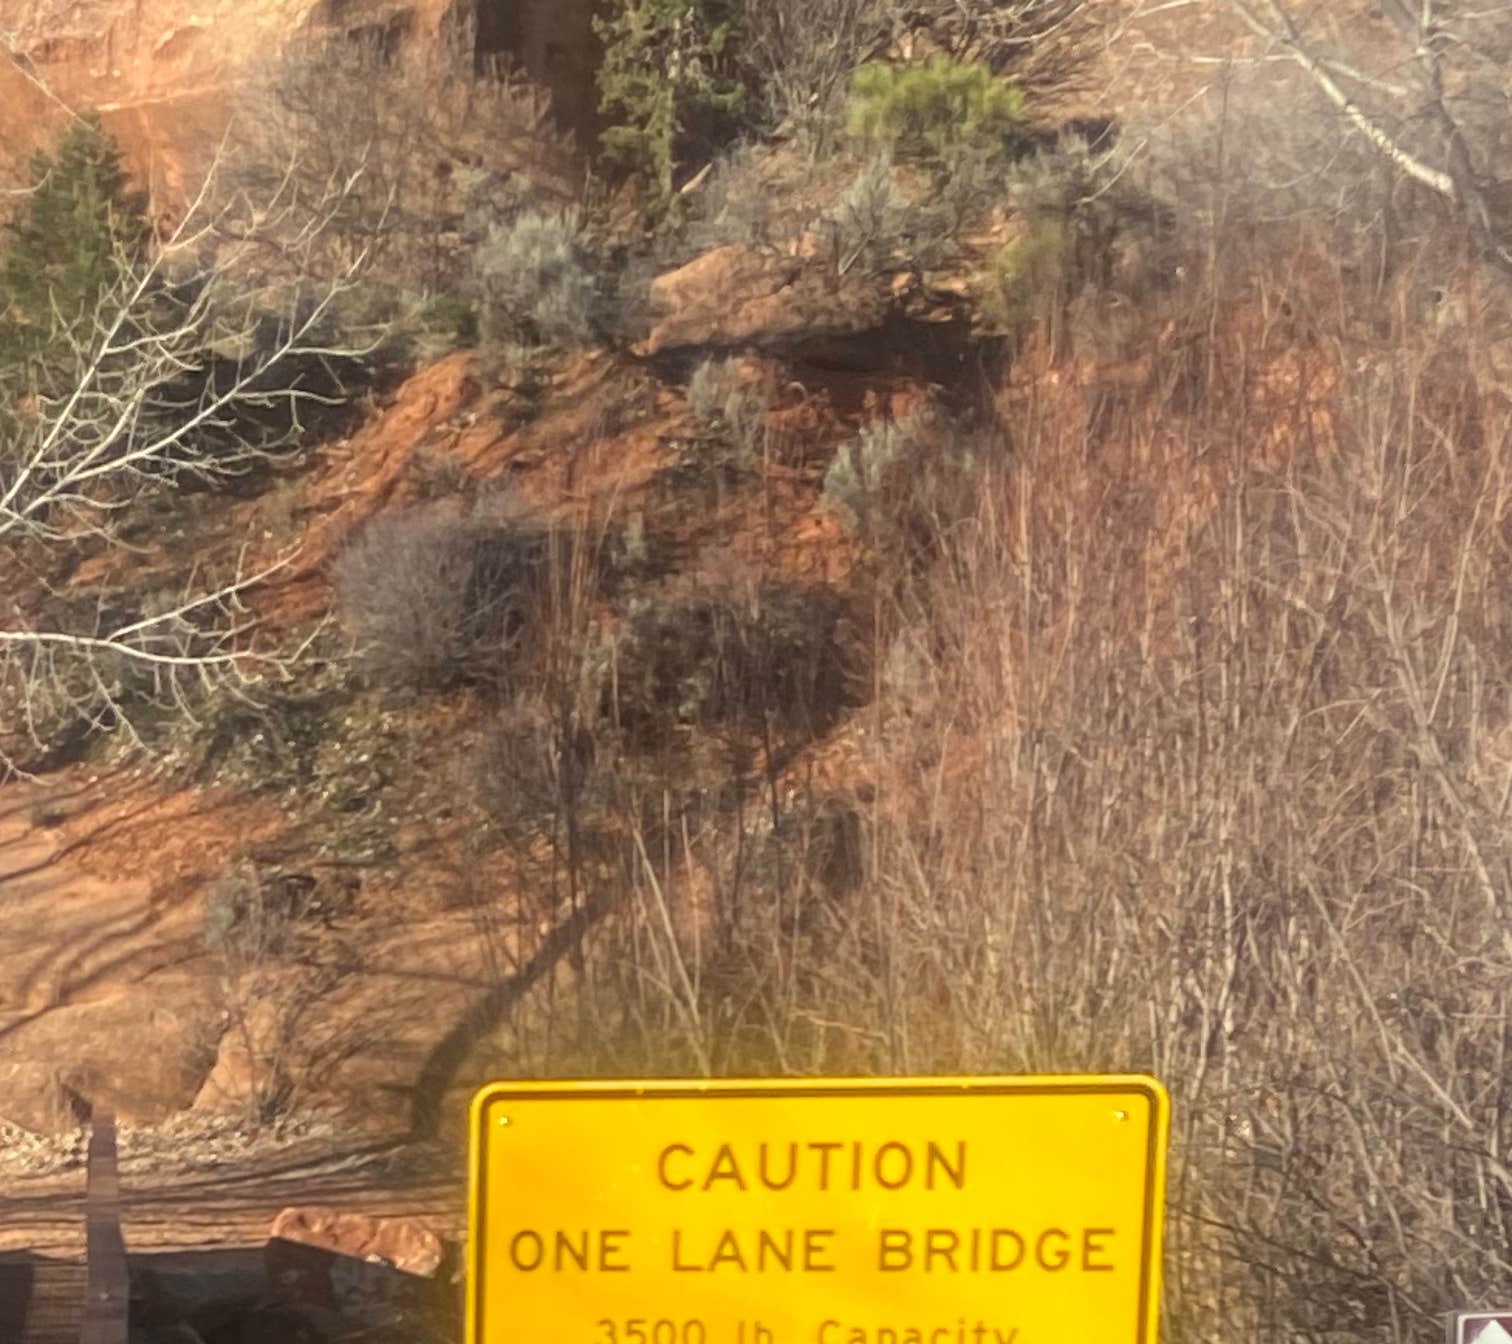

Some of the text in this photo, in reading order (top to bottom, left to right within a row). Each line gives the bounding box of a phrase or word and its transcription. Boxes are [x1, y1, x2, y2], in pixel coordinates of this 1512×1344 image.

[658, 1141, 967, 1192] CAUTION
[510, 1228, 1116, 1273] ONE LANE BRIDGE
